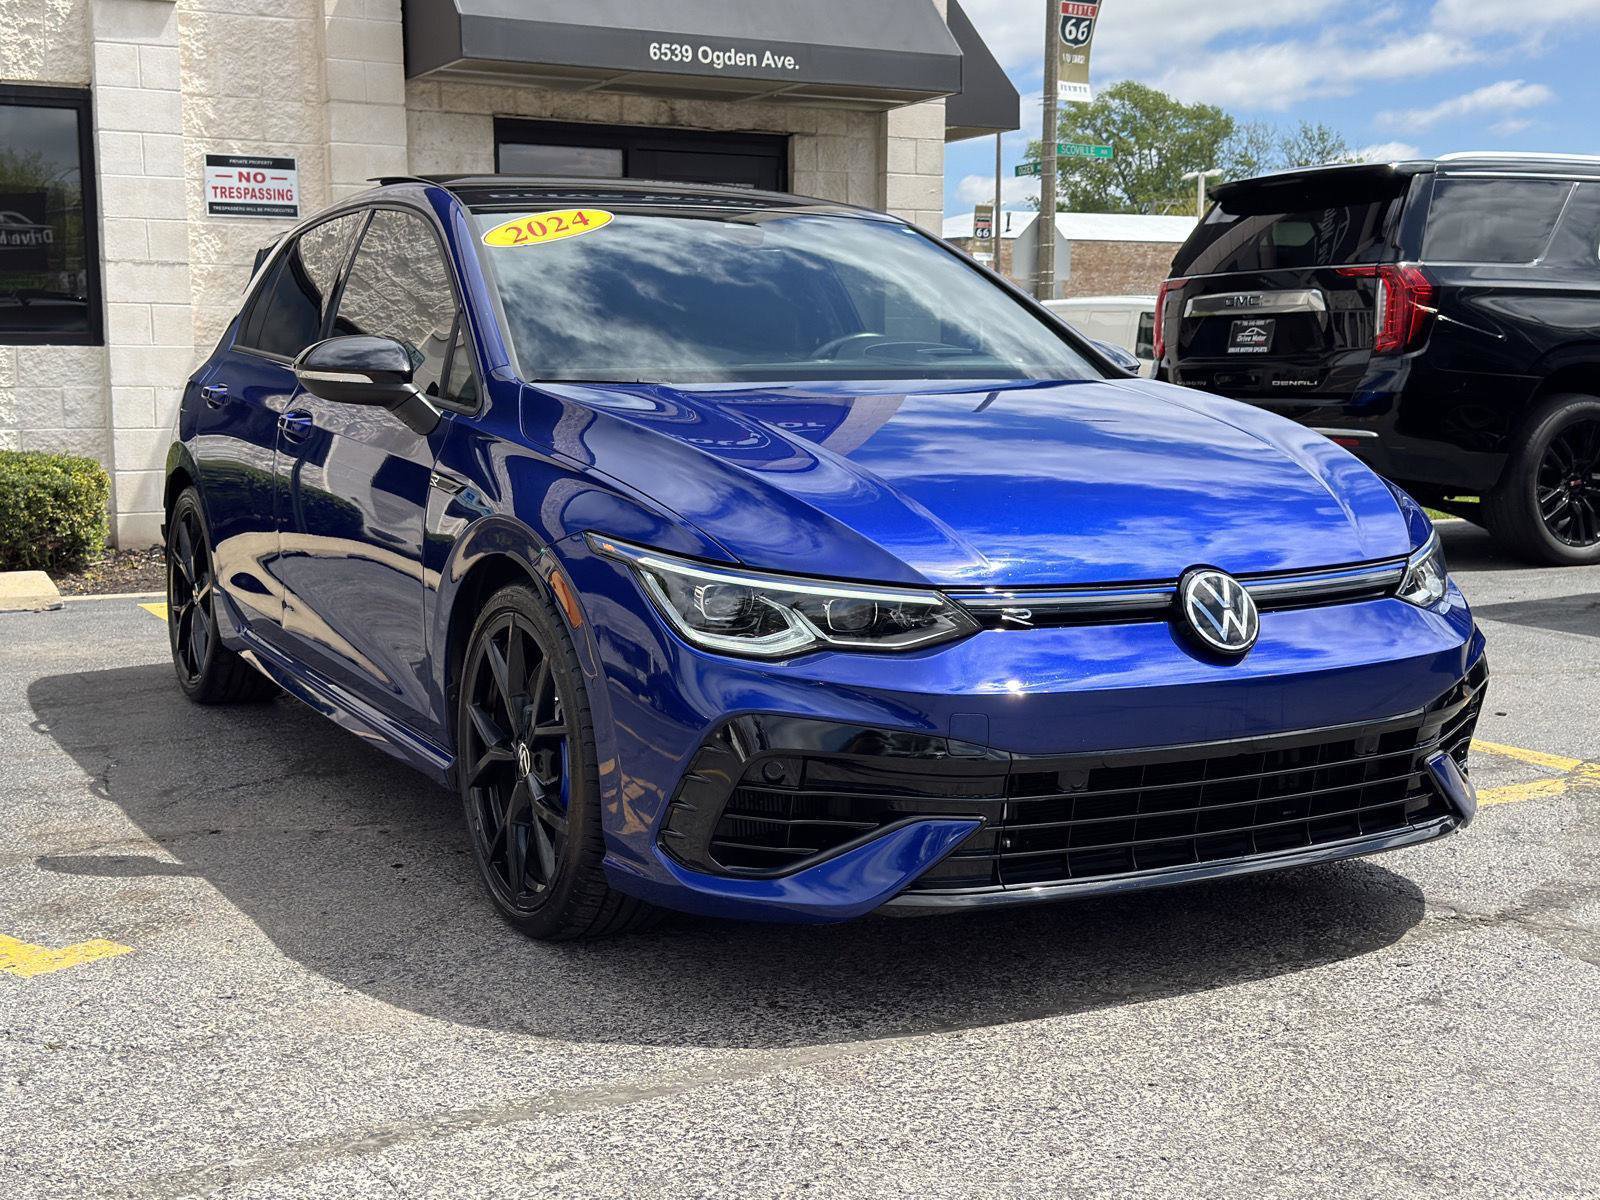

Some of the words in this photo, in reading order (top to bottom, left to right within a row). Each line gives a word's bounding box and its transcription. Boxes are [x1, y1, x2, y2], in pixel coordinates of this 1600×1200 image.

[1068, 4, 1093, 17] ROUTE
[1065, 18, 1091, 41] 66
[649, 42, 692, 62] 6539
[698, 45, 757, 69] Ogden
[761, 50, 800, 70] Ave.
[1061, 144, 1096, 155] SCOVILLE
[238, 171, 266, 184] NO
[211, 186, 293, 202] TRESPASSING
[505, 211, 590, 243] 2024
[976, 228, 989, 238] 66
[1224, 294, 1263, 307] GMC
